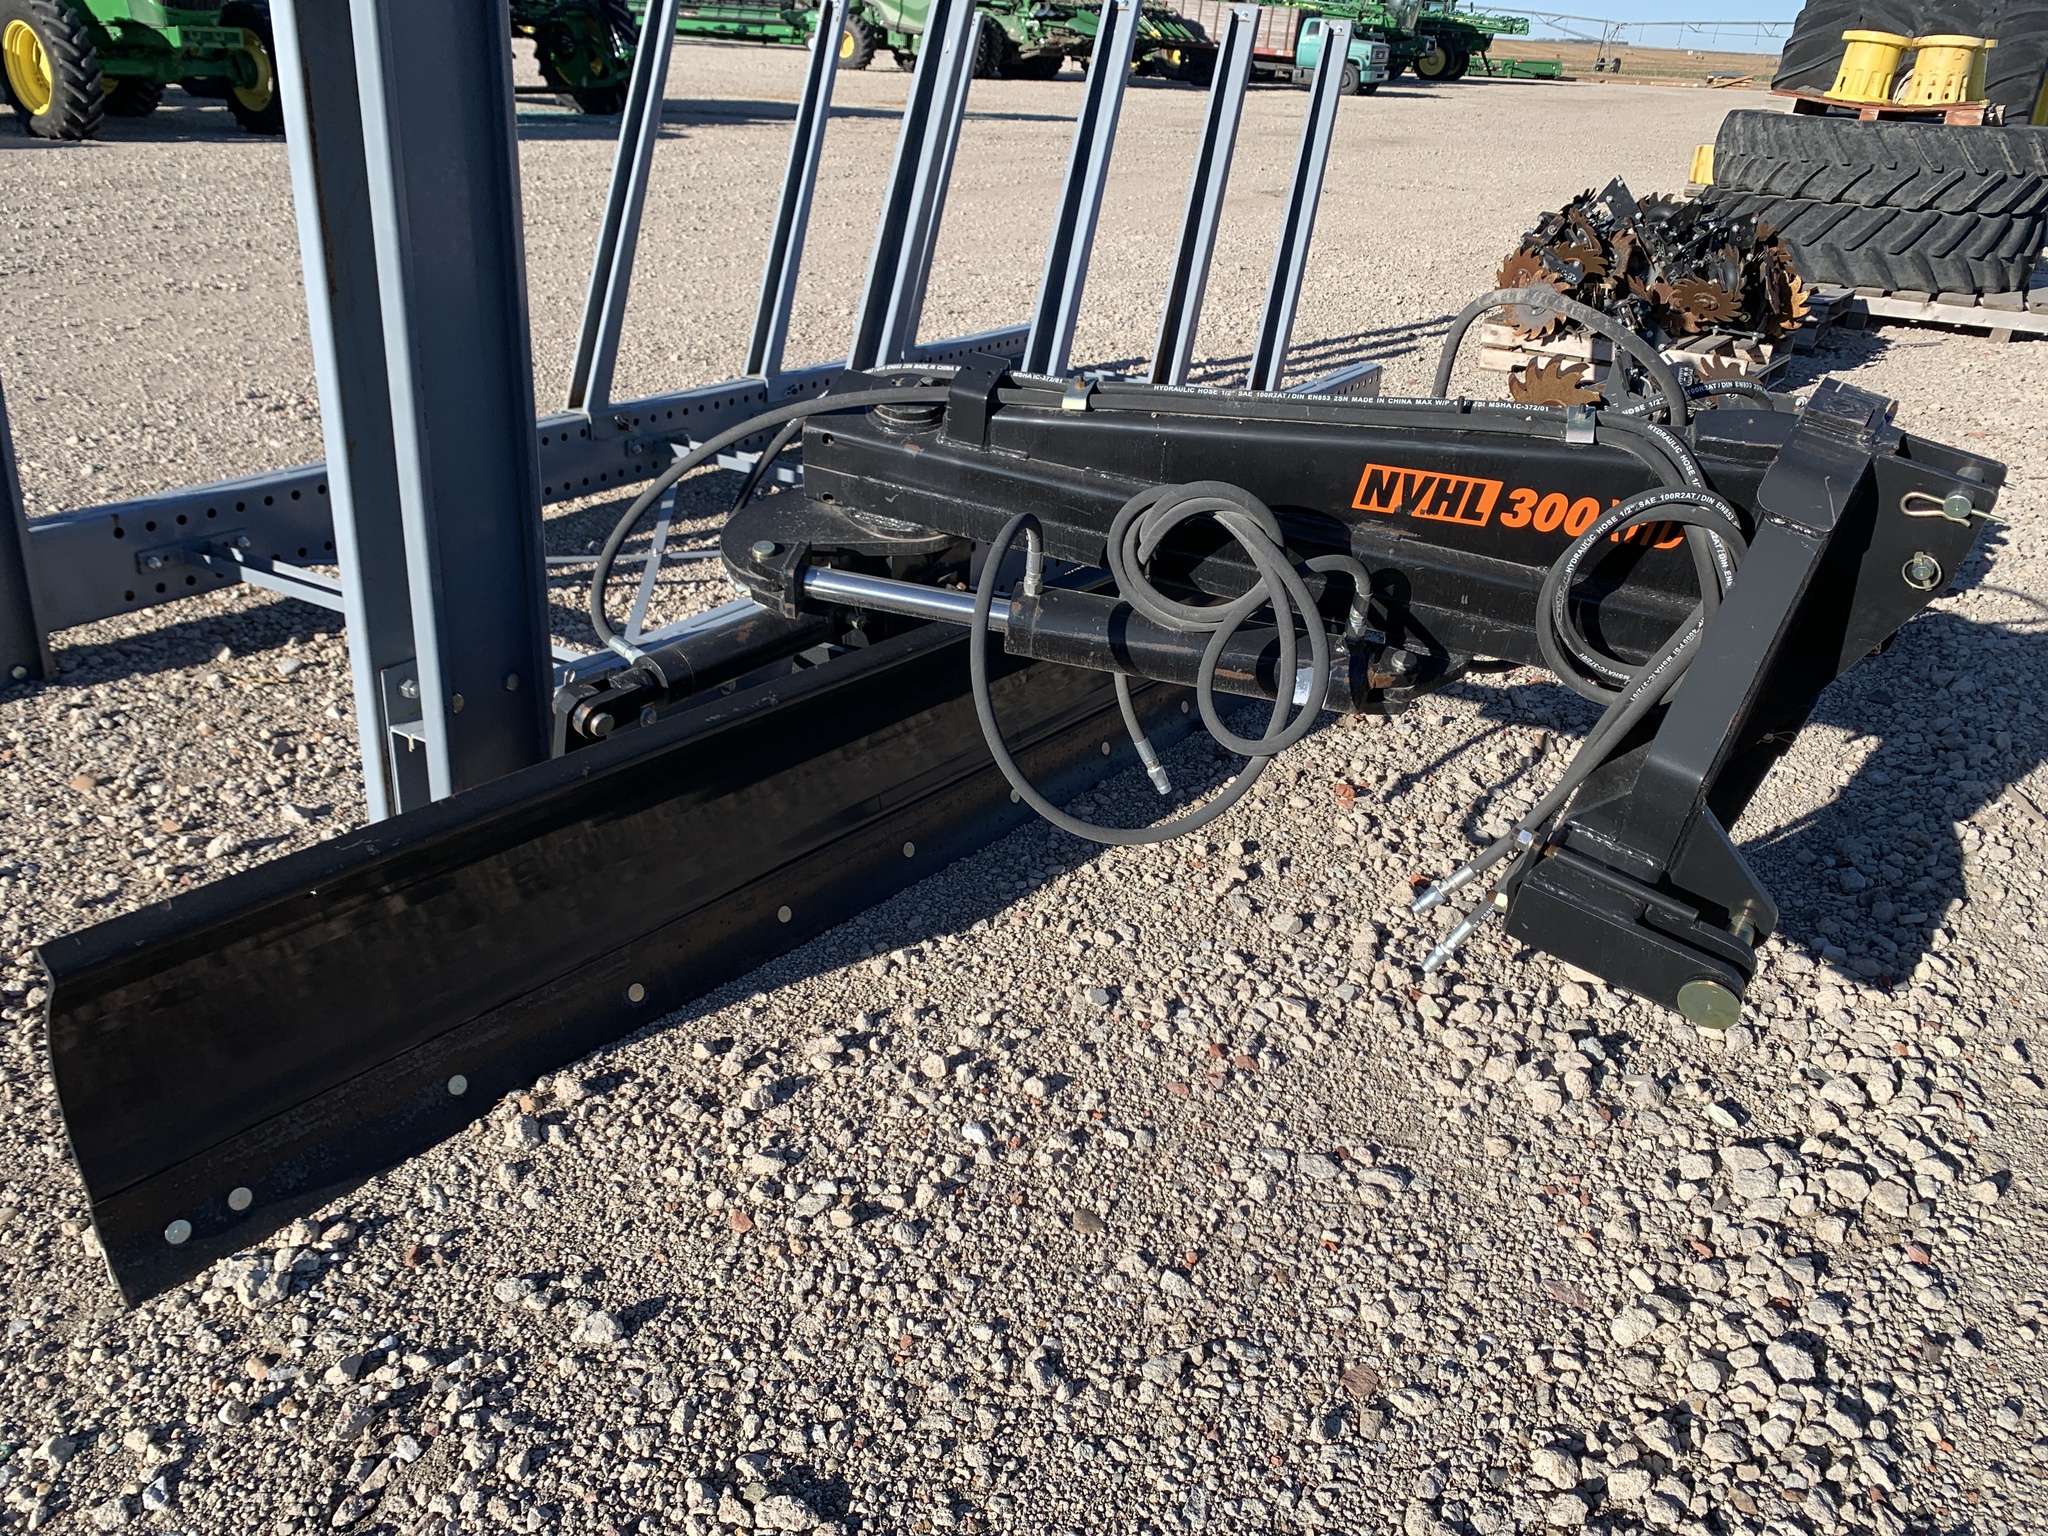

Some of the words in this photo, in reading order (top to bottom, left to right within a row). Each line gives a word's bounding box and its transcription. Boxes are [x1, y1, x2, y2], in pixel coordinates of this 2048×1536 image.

[1032, 374, 1064, 384] IC-372/01
[1153, 385, 1195, 394] HYDRAULIC
[1308, 393, 1331, 401] EN853
[1334, 394, 1349, 402] 2SN
[1488, 400, 1512, 409] MSHA
[1512, 404, 1549, 412] IC-372/01
[1647, 424, 1682, 454] HYDRAULIC
[1680, 454, 1696, 476] HOSE
[1359, 468, 1488, 522] NVHL
[1565, 533, 1596, 573] HYDRAULIC
[1596, 515, 1618, 534] HOSE
[1638, 496, 1656, 508] SAE
[1715, 502, 1734, 521] EN853
[1682, 628, 1698, 644] 4000
[1672, 642, 1684, 656] PSI
[1654, 655, 1674, 674] MSHA
[1608, 670, 1631, 680] MSHA
